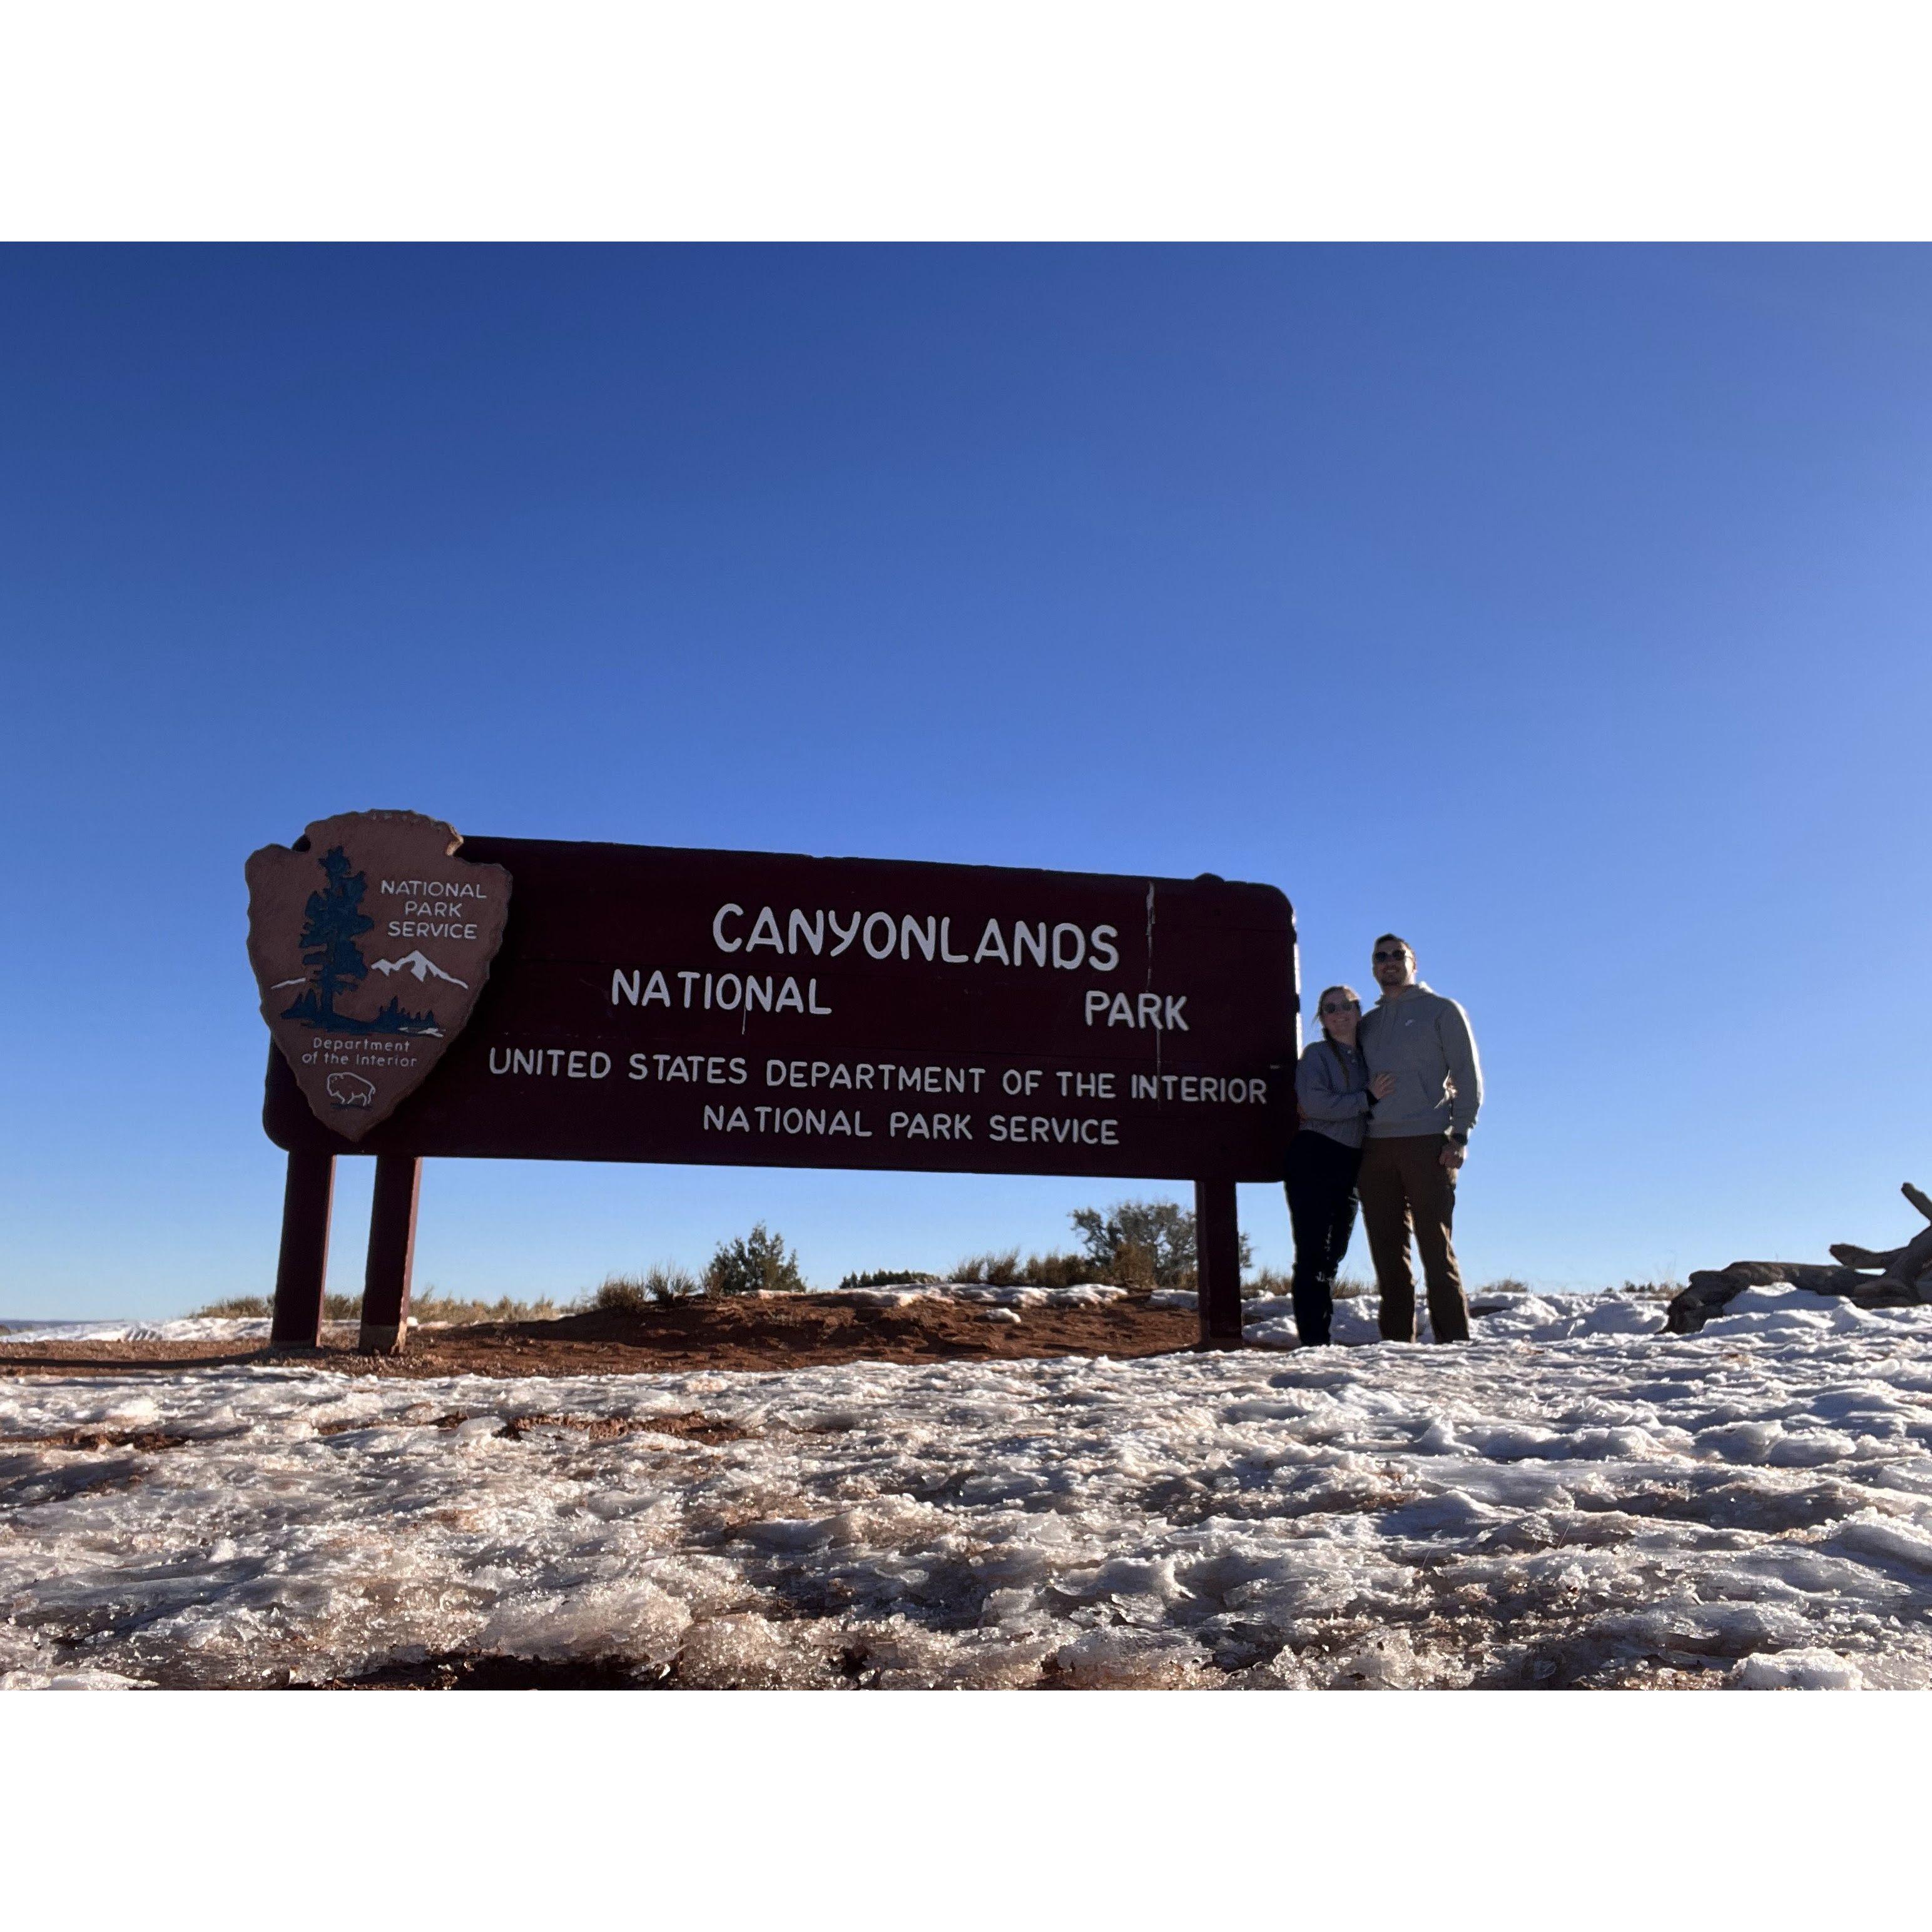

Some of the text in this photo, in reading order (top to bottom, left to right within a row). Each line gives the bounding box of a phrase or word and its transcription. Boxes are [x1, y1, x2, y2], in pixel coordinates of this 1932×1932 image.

[381, 880, 486, 898] NATIONAL
[405, 900, 463, 918] PARK
[387, 921, 477, 939] SERVICE
[713, 903, 1119, 972] CANYONLANDS
[611, 969, 1189, 1031] NATIONAL PARK
[313, 1037, 410, 1051] Department
[302, 1051, 417, 1067] of the Interior
[489, 1047, 1266, 1104] UNITED STATES DEPARTMENT OF THE INTERIOR
[703, 1105, 1119, 1145] NATIONAL PARK SERVICE
